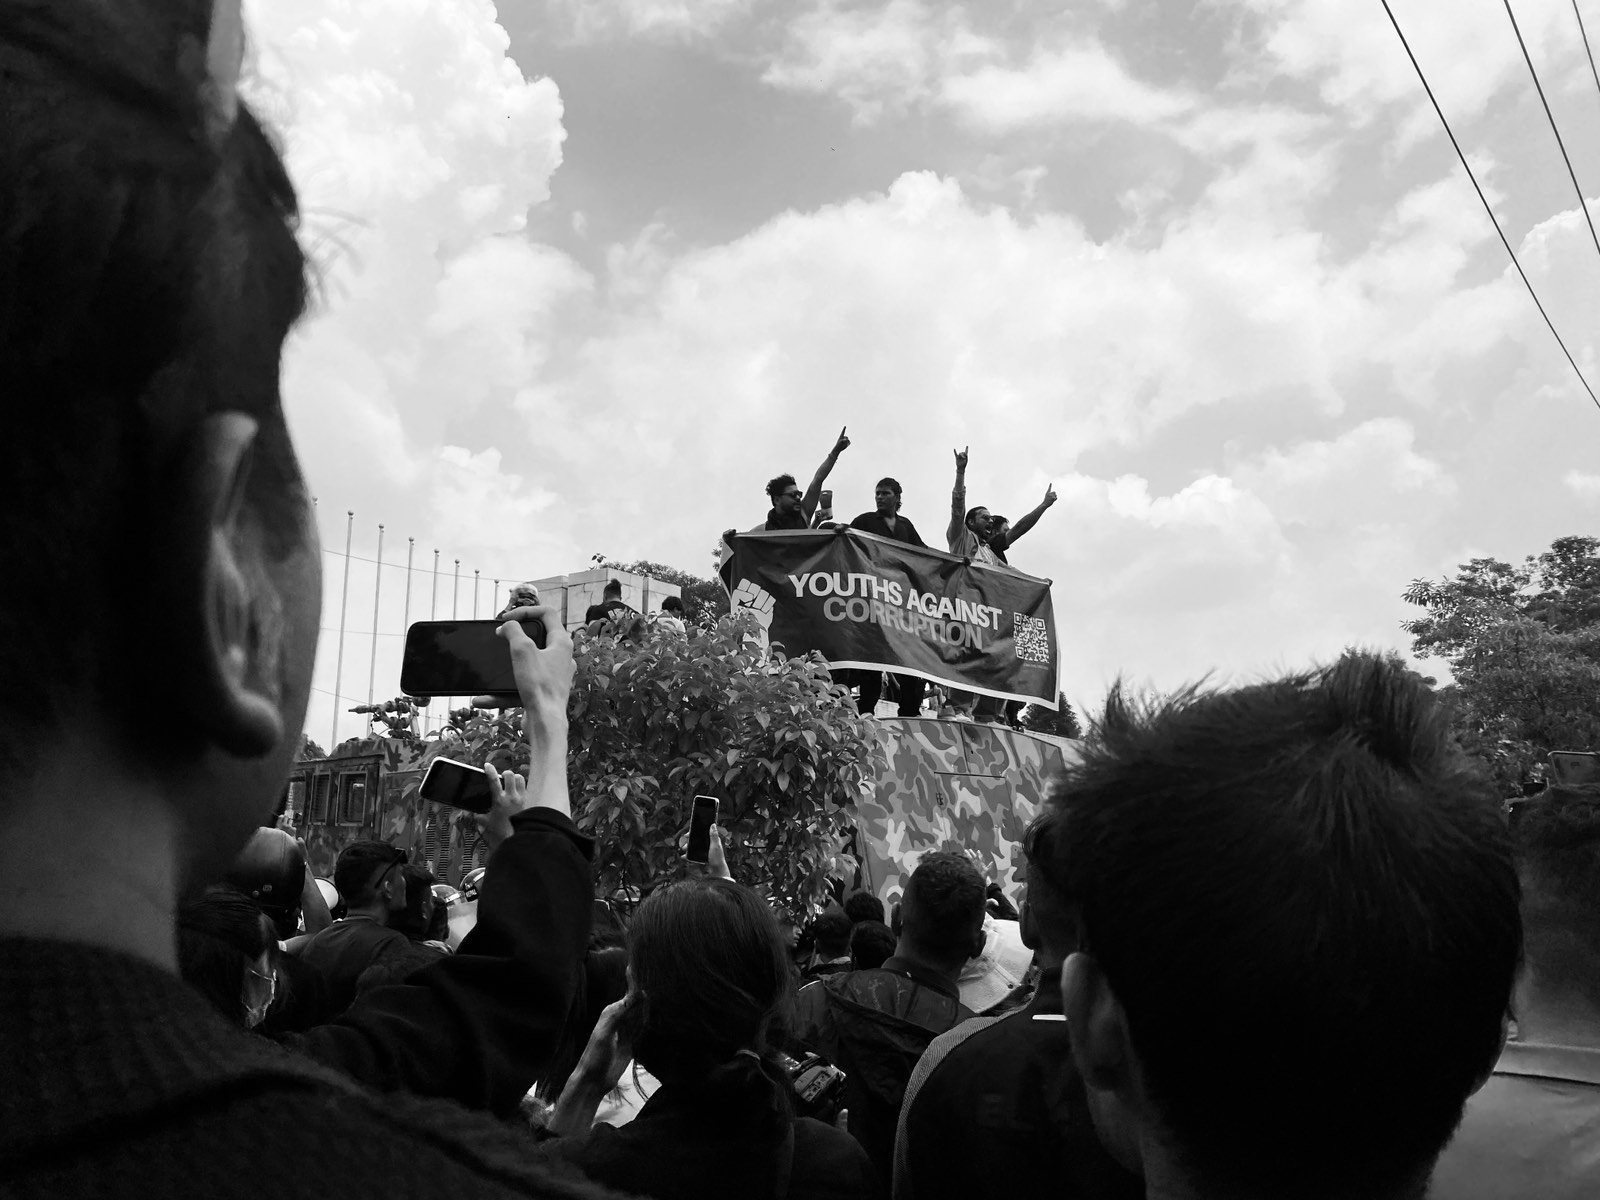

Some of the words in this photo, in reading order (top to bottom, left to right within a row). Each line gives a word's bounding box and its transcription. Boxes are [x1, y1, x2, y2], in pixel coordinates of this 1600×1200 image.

[788, 572, 902, 606] YOUTHS
[907, 588, 1002, 630] AGAINST
[823, 597, 982, 649] CORRUPTION
